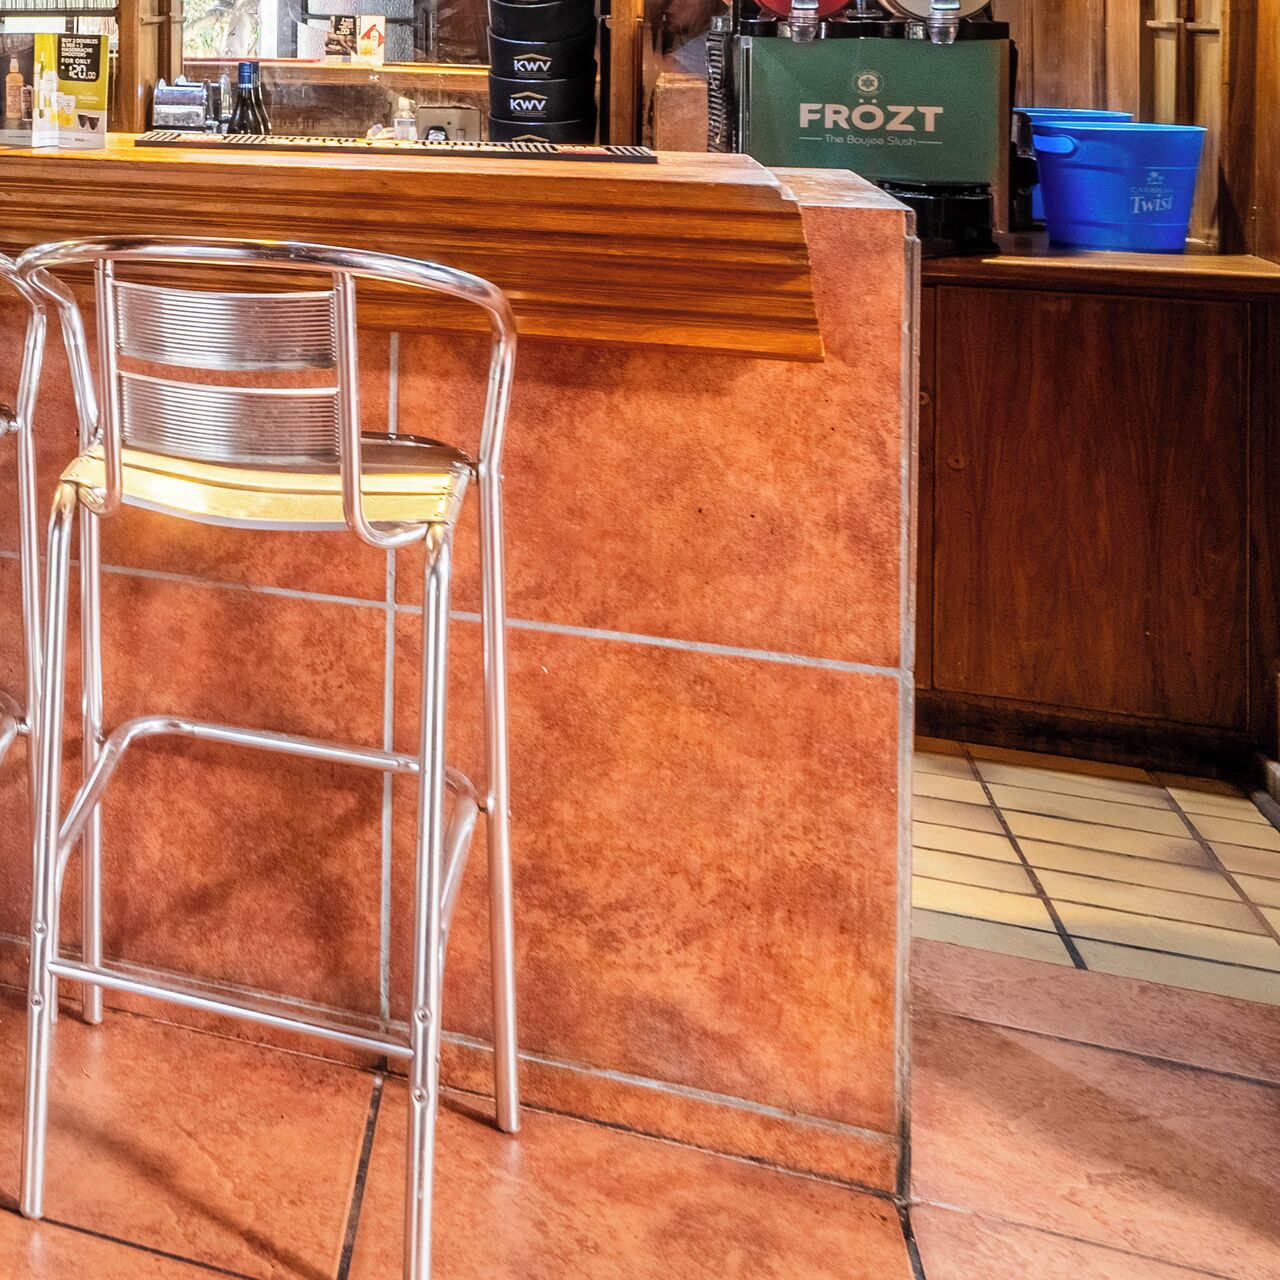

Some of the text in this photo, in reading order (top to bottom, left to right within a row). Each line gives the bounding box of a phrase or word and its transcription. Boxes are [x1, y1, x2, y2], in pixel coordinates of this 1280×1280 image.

[514, 60, 552, 72] KWV
[510, 99, 546, 111] KWV
[799, 98, 944, 132] FRÖZT
[825, 134, 917, 146] The Boujee Slush
[1130, 196, 1173, 214] Twist
